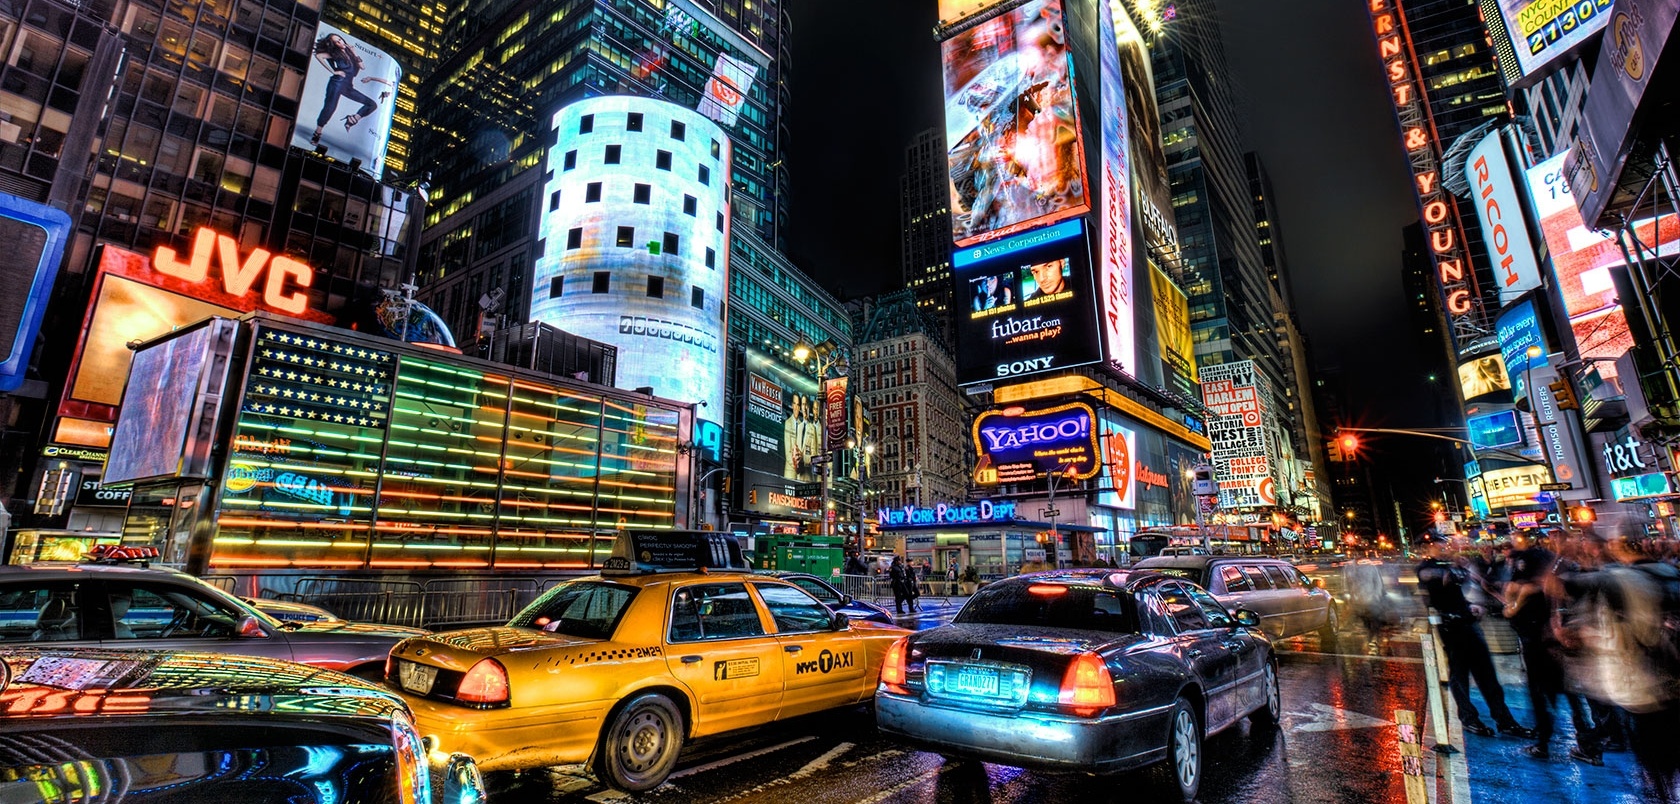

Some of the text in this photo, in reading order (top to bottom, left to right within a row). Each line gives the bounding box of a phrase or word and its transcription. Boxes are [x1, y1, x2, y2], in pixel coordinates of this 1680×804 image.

[1140, 189, 1177, 247] BUFFALO
[1406, 127, 1426, 150] &
[1416, 172, 1472, 313] YOUNG
[1473, 154, 1519, 288] RICOH
[984, 229, 1061, 257] News Corporation
[153, 226, 313, 315] JVC
[1107, 273, 1119, 335] Arm
[991, 316, 1061, 338] fubar.com
[1516, 315, 1535, 332] every
[1039, 326, 1062, 340] play?
[997, 356, 1054, 376] SONY
[1200, 361, 1251, 374] CAMBRIA HEIGHTS
[1231, 366, 1251, 375] EAST
[1232, 372, 1252, 386] NY
[1204, 381, 1230, 394] EAST
[1205, 389, 1254, 405] HARLEM
[1537, 385, 1554, 420] REUTERS
[830, 401, 842, 411] FREE
[1230, 401, 1255, 413] OPEN
[1209, 420, 1243, 430] ASTORIA
[982, 415, 1088, 451] YAHOO!
[1210, 428, 1244, 442] WEST
[1246, 427, 1257, 446] SOHO
[1212, 440, 1247, 450] VILLAGE
[1230, 457, 1266, 466] COLLEGE
[1603, 436, 1645, 475] at&t
[1215, 461, 1224, 475] BAY
[1231, 466, 1255, 474] POINT
[1136, 460, 1169, 491] Walgreens
[1219, 480, 1251, 488] MARBLE
[1485, 479, 1500, 491] THE
[1229, 487, 1258, 496] MILL
[1230, 496, 1259, 505] BSIN
[937, 503, 978, 522] POLICE
[981, 500, 1015, 521] DEPT
[609, 559, 624, 569] 2M29
[636, 646, 663, 658] 2M29
[796, 649, 854, 675] NYC TAXI
[960, 674, 996, 690] GRAND277
